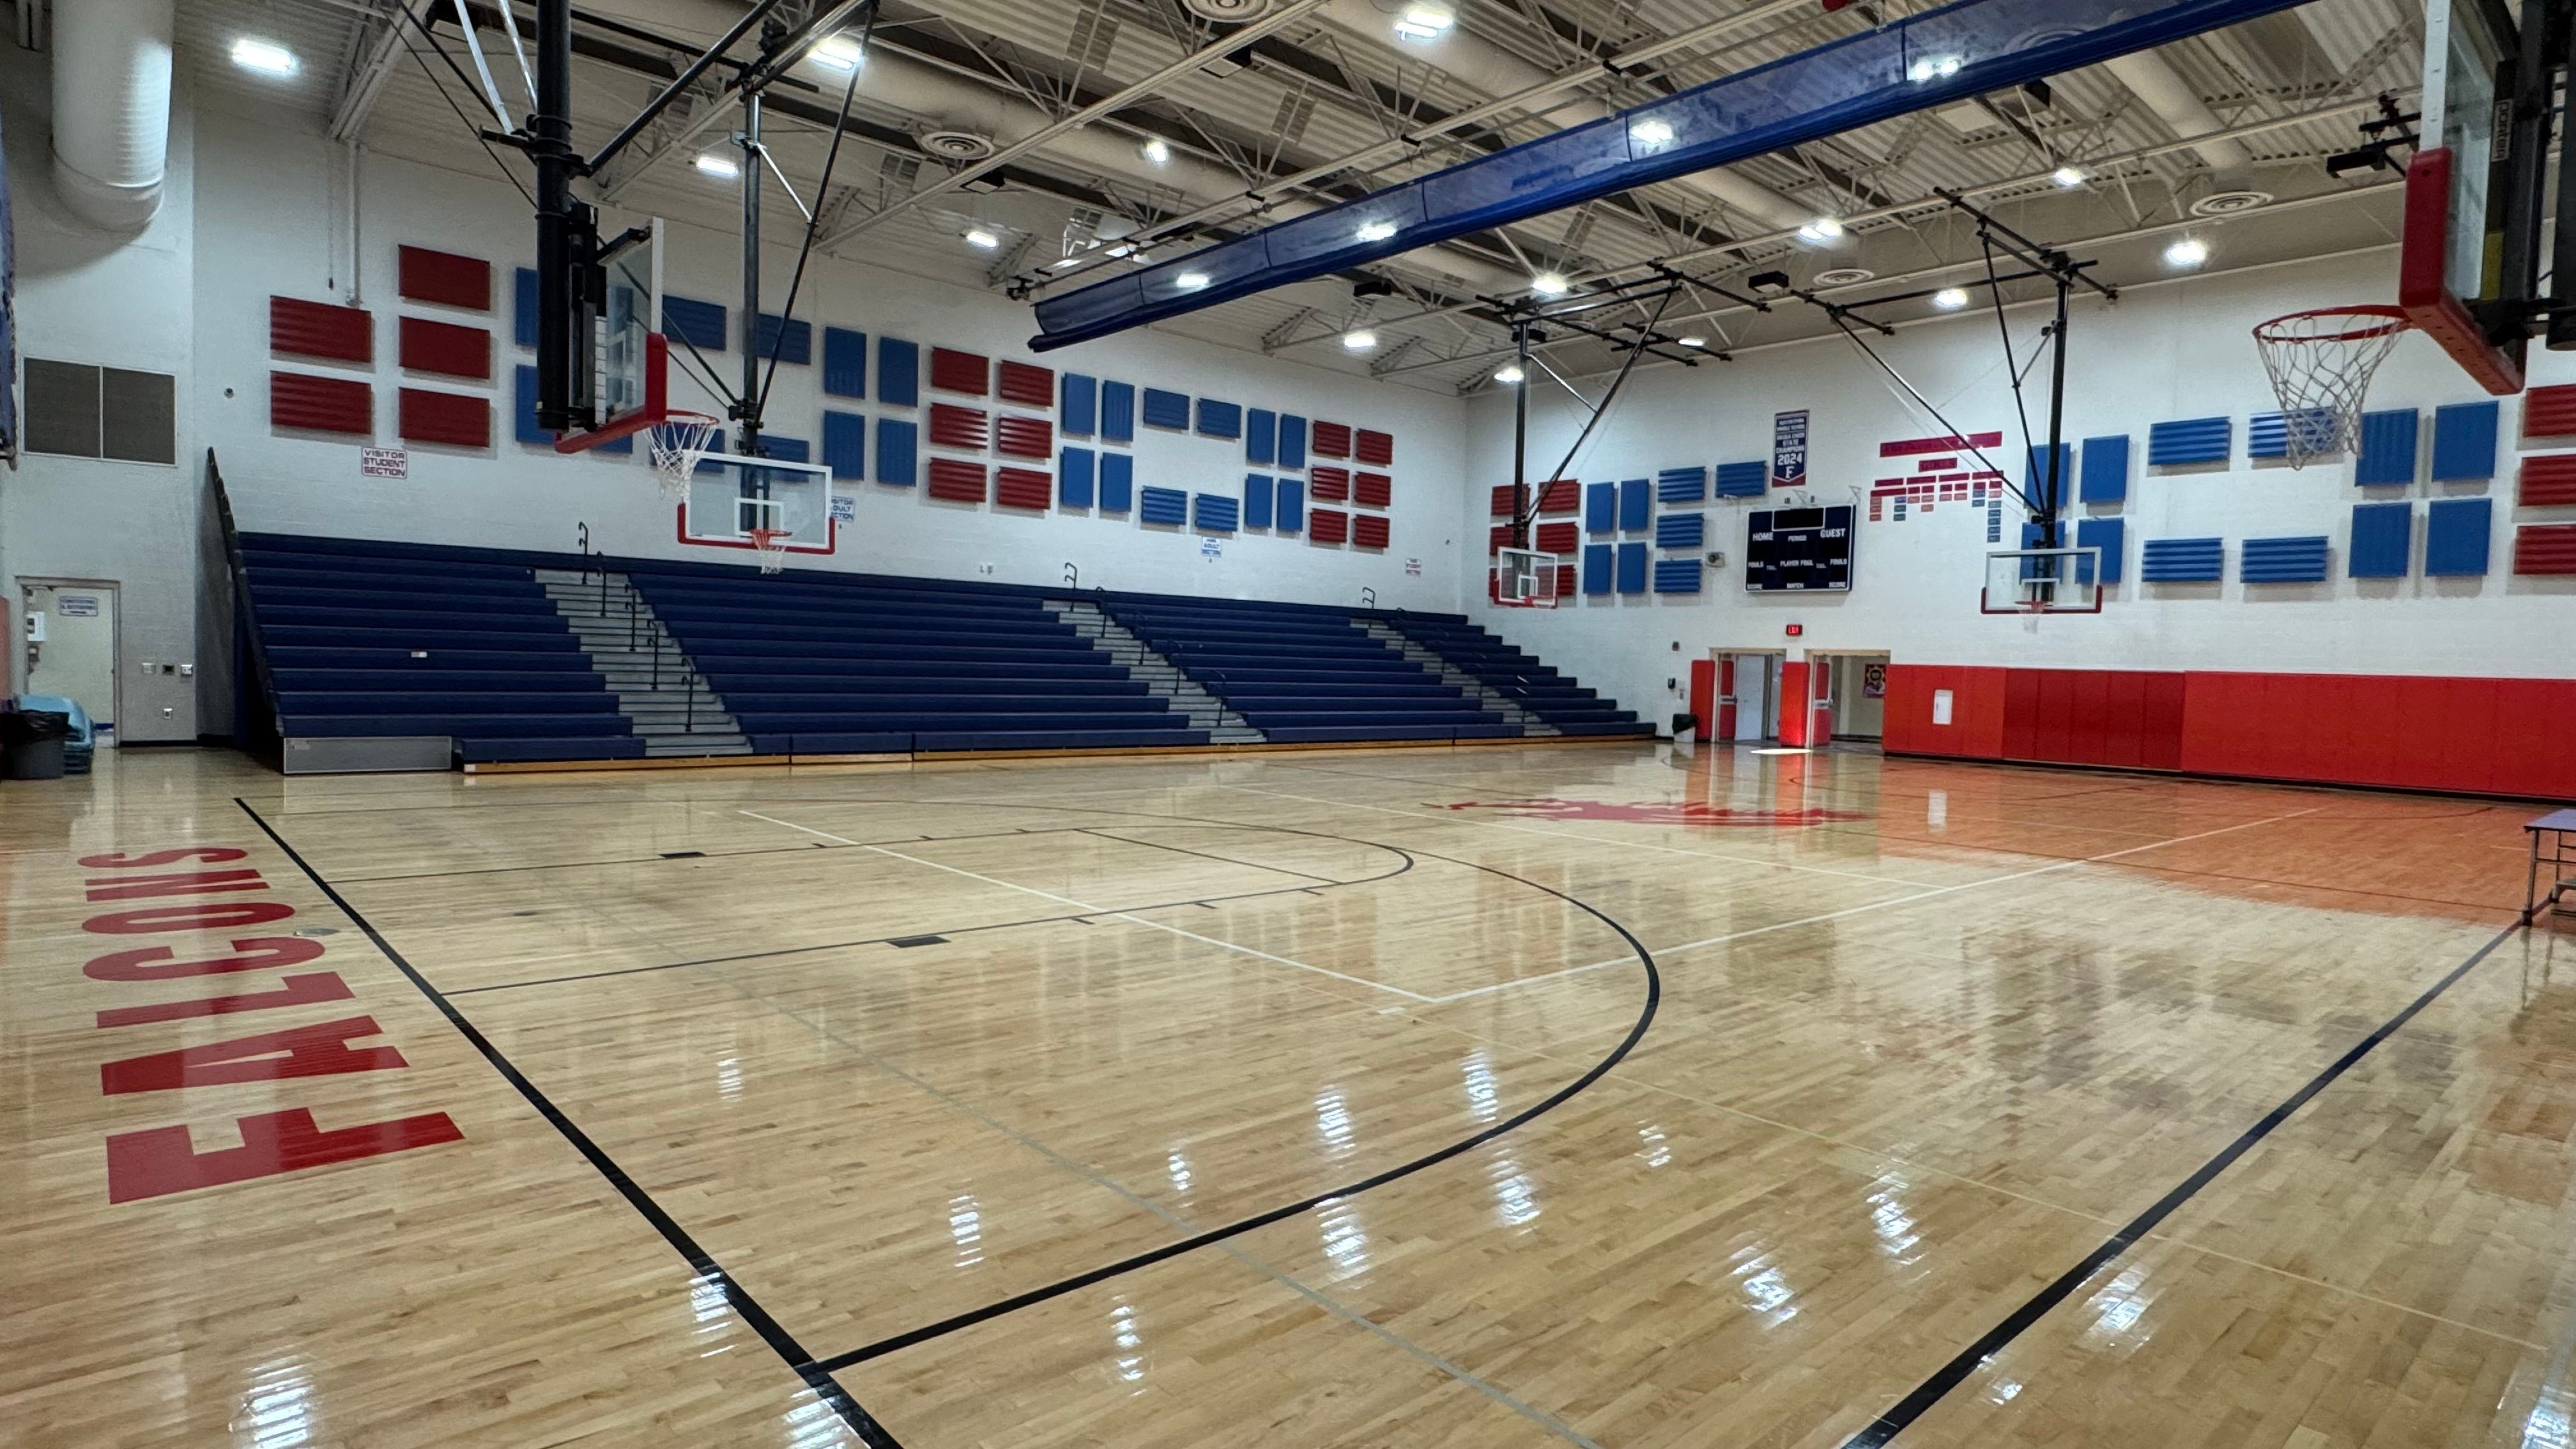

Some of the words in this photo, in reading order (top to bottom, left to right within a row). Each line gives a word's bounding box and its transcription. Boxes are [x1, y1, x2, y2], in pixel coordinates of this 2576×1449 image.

[364, 450, 405, 459] VISITOR
[1777, 452, 1802, 466] 2024
[364, 457, 405, 468] STUDENT
[364, 467, 405, 477] SECTION
[1785, 466, 1795, 479] F
[1752, 532, 1774, 541] HOME
[1820, 528, 1846, 538] GUEST
[77, 848, 465, 1204] FALCONS
